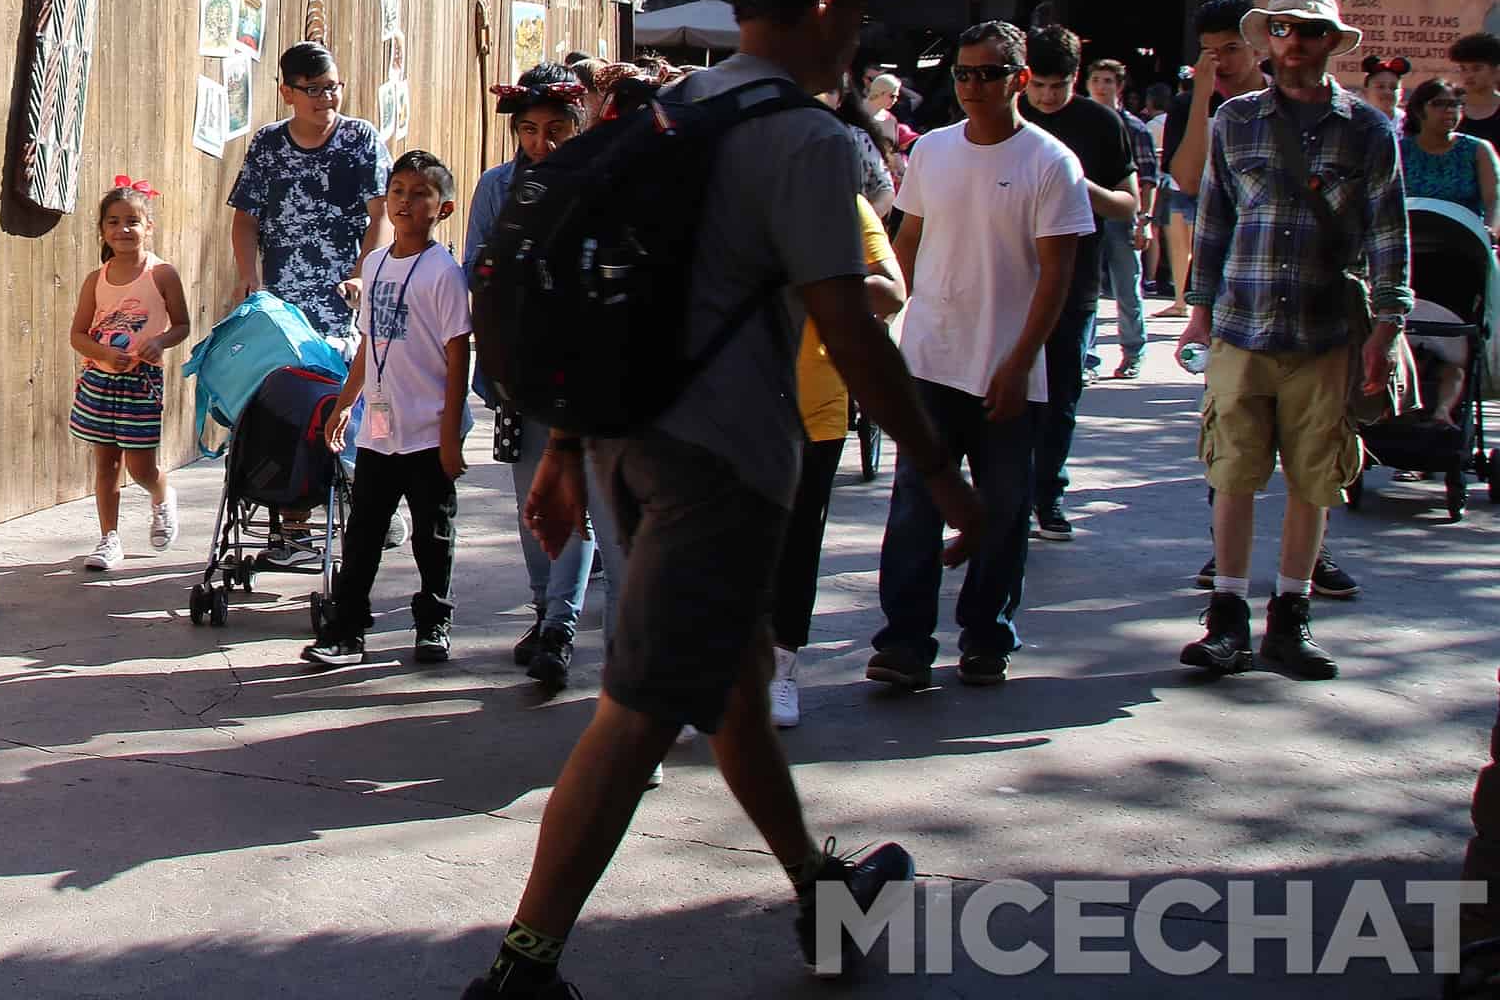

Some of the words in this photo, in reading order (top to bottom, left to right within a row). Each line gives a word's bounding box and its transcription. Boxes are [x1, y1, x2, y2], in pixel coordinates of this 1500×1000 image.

[1391, 15, 1415, 27] ALL
[1419, 16, 1459, 28] PRAMS
[1363, 46, 1447, 59] PERAMBULATO
